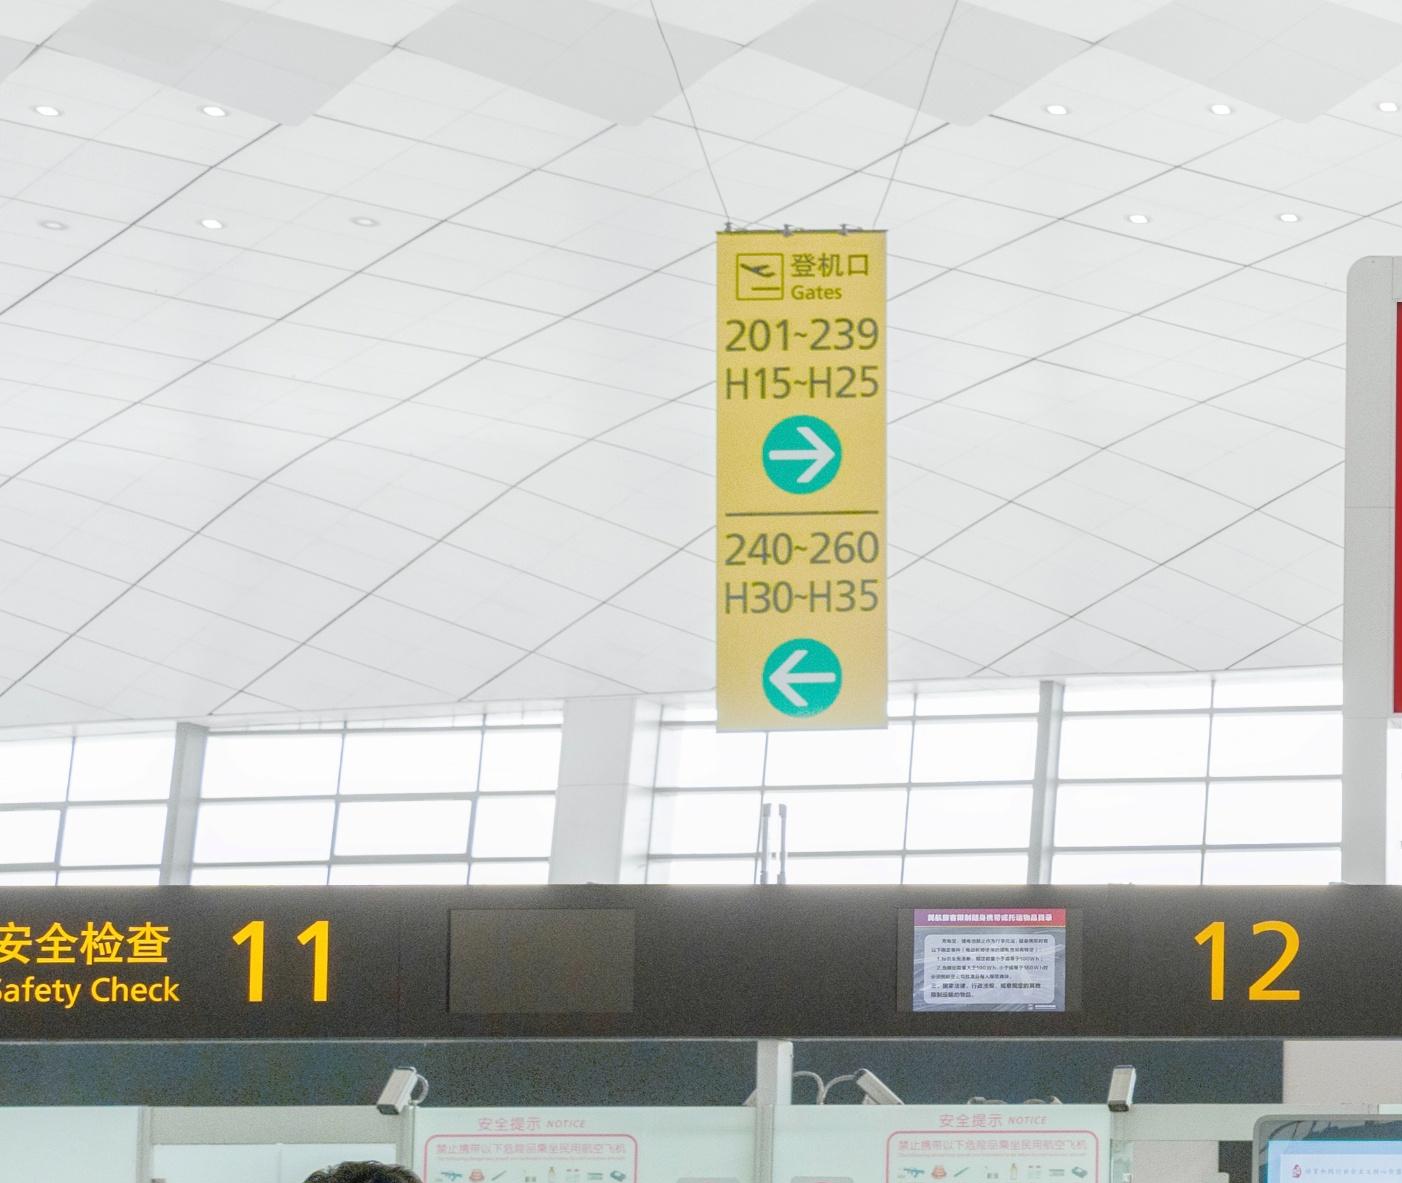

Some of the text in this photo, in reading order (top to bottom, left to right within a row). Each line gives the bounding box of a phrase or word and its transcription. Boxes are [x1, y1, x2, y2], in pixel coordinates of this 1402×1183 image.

[790, 252, 869, 278] 登机口
[790, 284, 843, 301] Gates
[0, 921, 171, 965] 安全检查
[232, 919, 330, 1003] 11
[1194, 920, 1301, 1002] 12
[0, 976, 180, 1009] afety Check
[479, 1117, 586, 1131] 安全提示 NOTICE
[939, 1114, 1047, 1128] 安全提示 NOTICE
